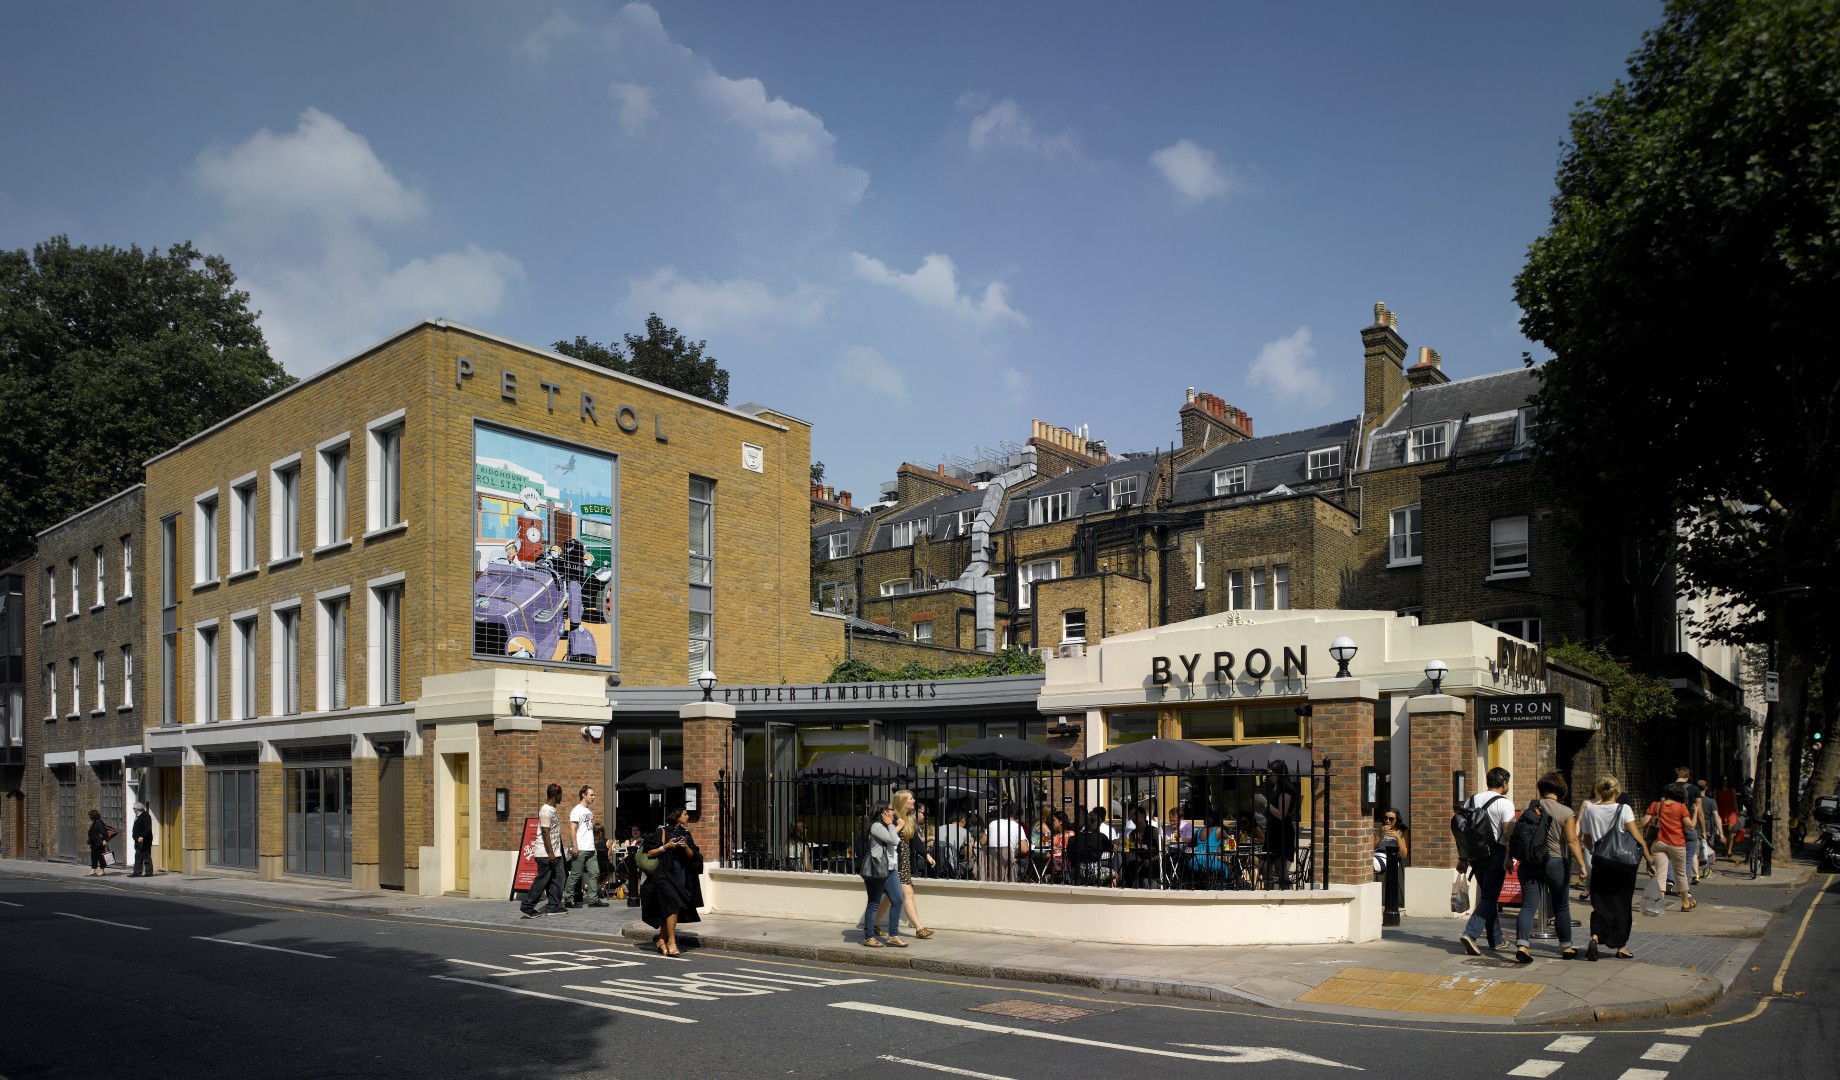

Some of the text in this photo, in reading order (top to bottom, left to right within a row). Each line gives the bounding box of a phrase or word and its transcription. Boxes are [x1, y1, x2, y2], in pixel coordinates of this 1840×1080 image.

[456, 356, 669, 442] PETROL
[500, 480, 542, 496] STATN
[1152, 645, 1308, 685] BYRON
[1497, 636, 1546, 681] BYRON
[725, 683, 937, 702] PROPER HAMBURGERS
[1489, 702, 1552, 715] BYRON
[446, 948, 692, 977] LEFT
[560, 967, 877, 1006] TURN
